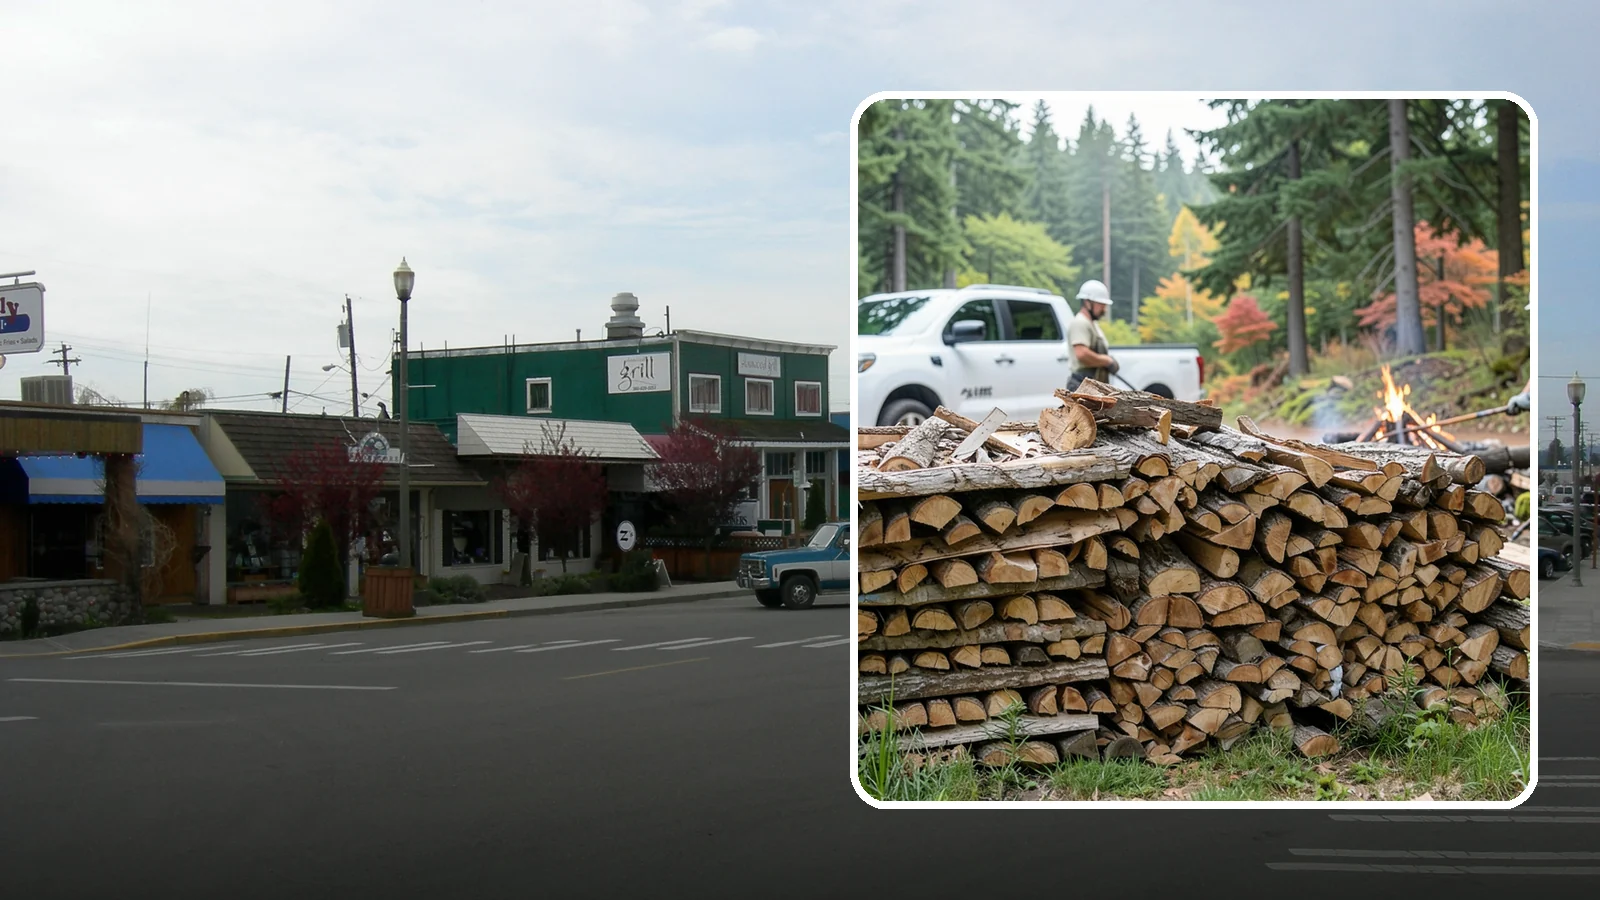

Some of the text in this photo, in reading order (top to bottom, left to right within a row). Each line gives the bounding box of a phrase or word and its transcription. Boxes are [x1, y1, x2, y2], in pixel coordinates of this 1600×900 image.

[3, 338, 16, 346] Fries
[20, 336, 38, 345] Salads
[618, 356, 654, 391] grill
